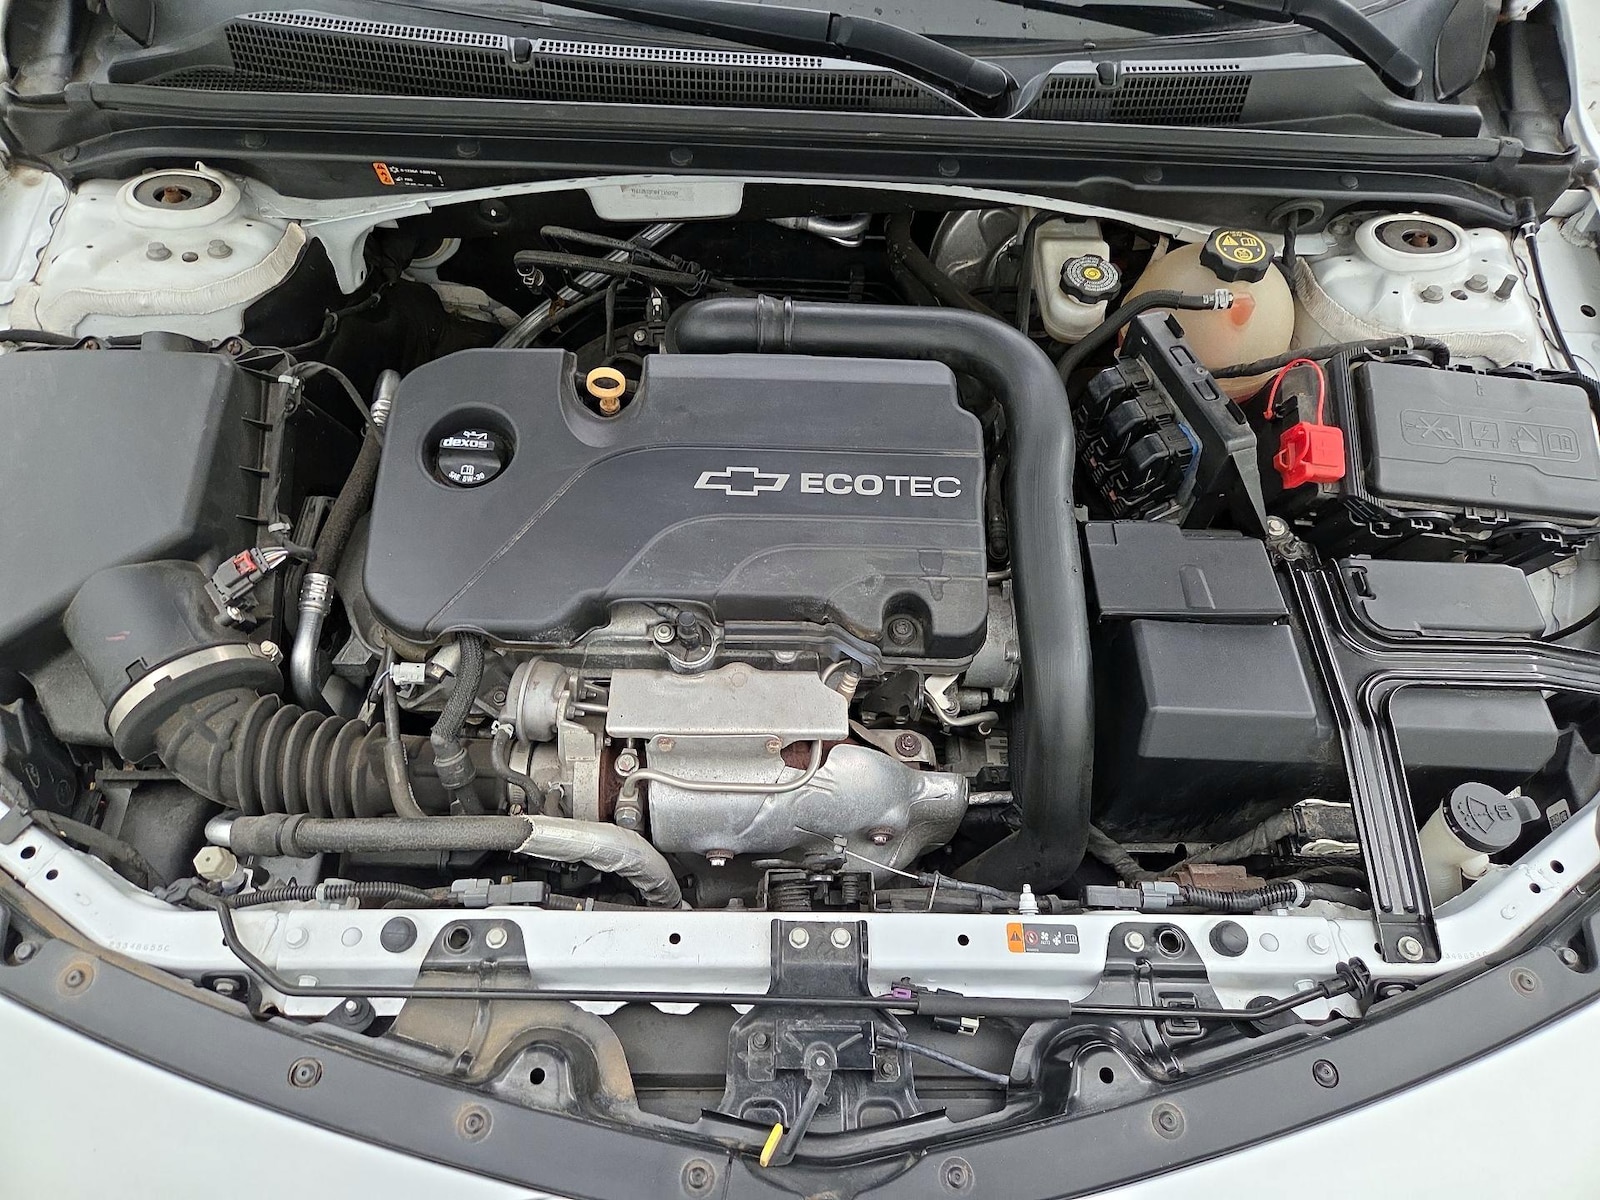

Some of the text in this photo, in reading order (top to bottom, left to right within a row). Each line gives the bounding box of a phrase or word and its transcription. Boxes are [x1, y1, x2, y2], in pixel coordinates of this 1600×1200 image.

[443, 437, 488, 448] dexos
[448, 471, 461, 481] SAE
[800, 472, 962, 498] ECOTEC
